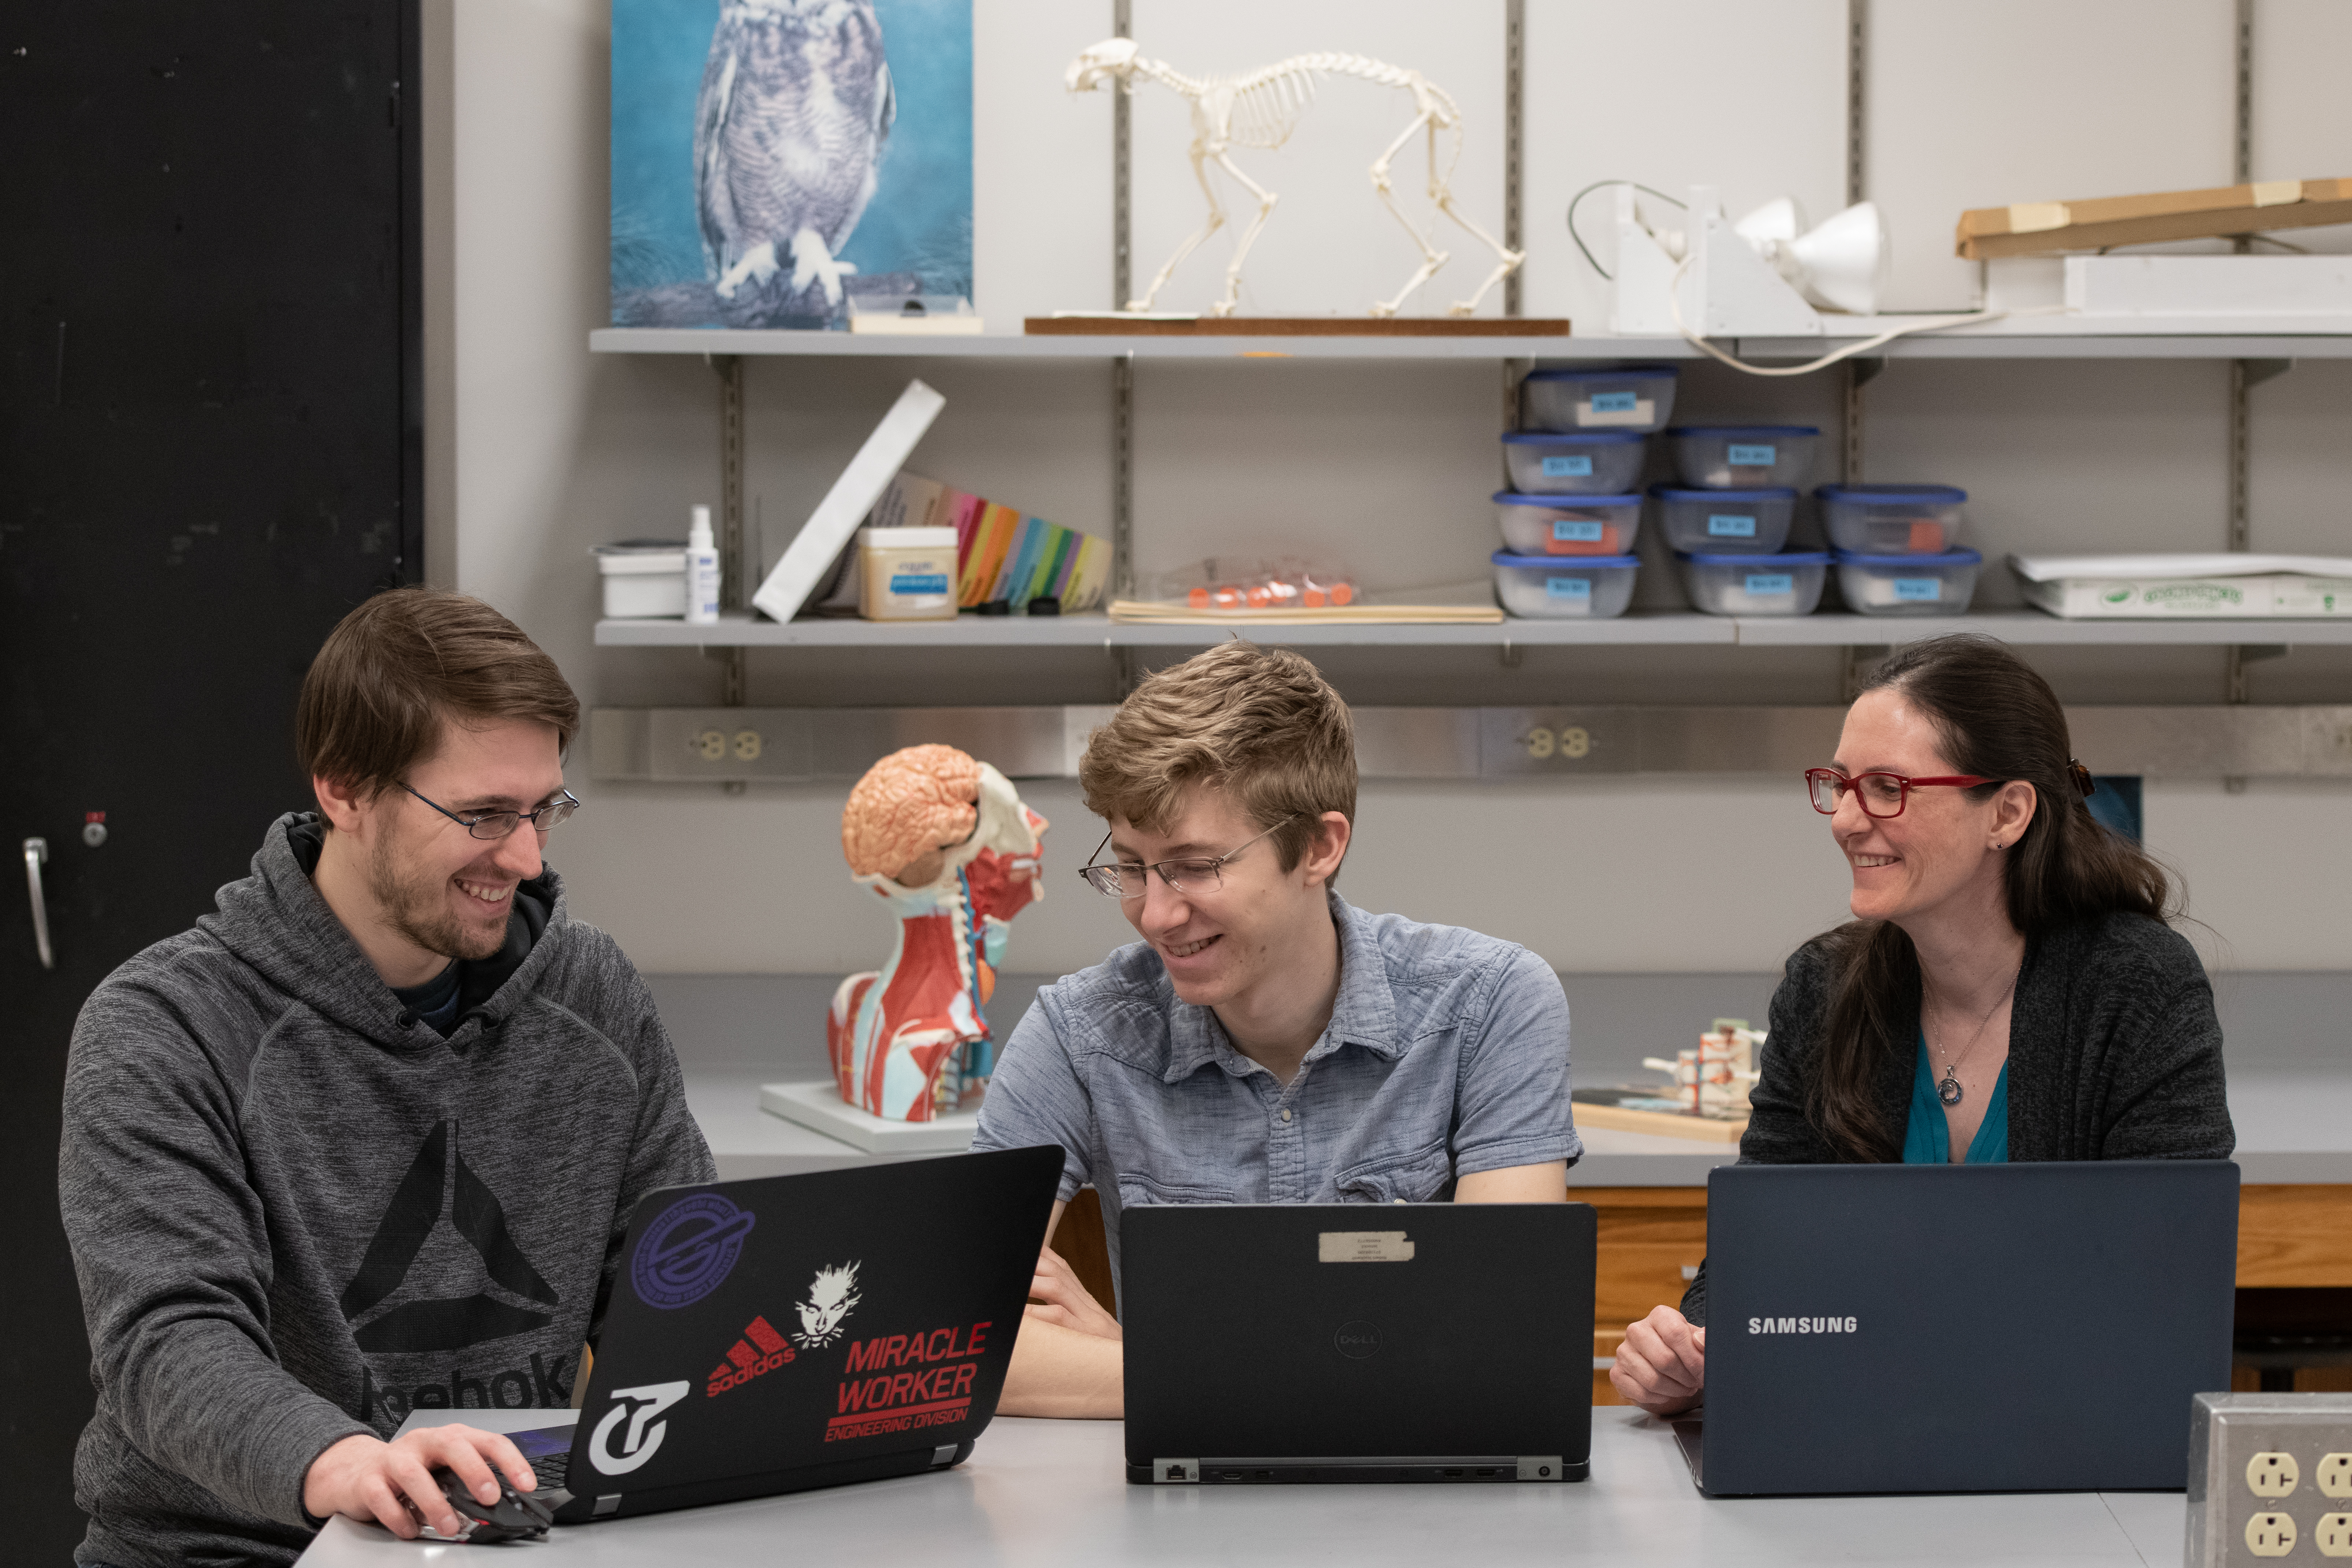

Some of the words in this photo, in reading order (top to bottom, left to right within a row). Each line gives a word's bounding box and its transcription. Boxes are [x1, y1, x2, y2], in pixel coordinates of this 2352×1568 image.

[1340, 1334, 1377, 1344] DELL
[1748, 1316, 1857, 1334] SAMSUNG
[845, 1322, 992, 1374] MIRACLE
[707, 1347, 796, 1398] sadidas
[838, 1363, 977, 1414] WORKER
[825, 1415, 912, 1442] ENGINEERING
[914, 1407, 969, 1429] DIVISION
